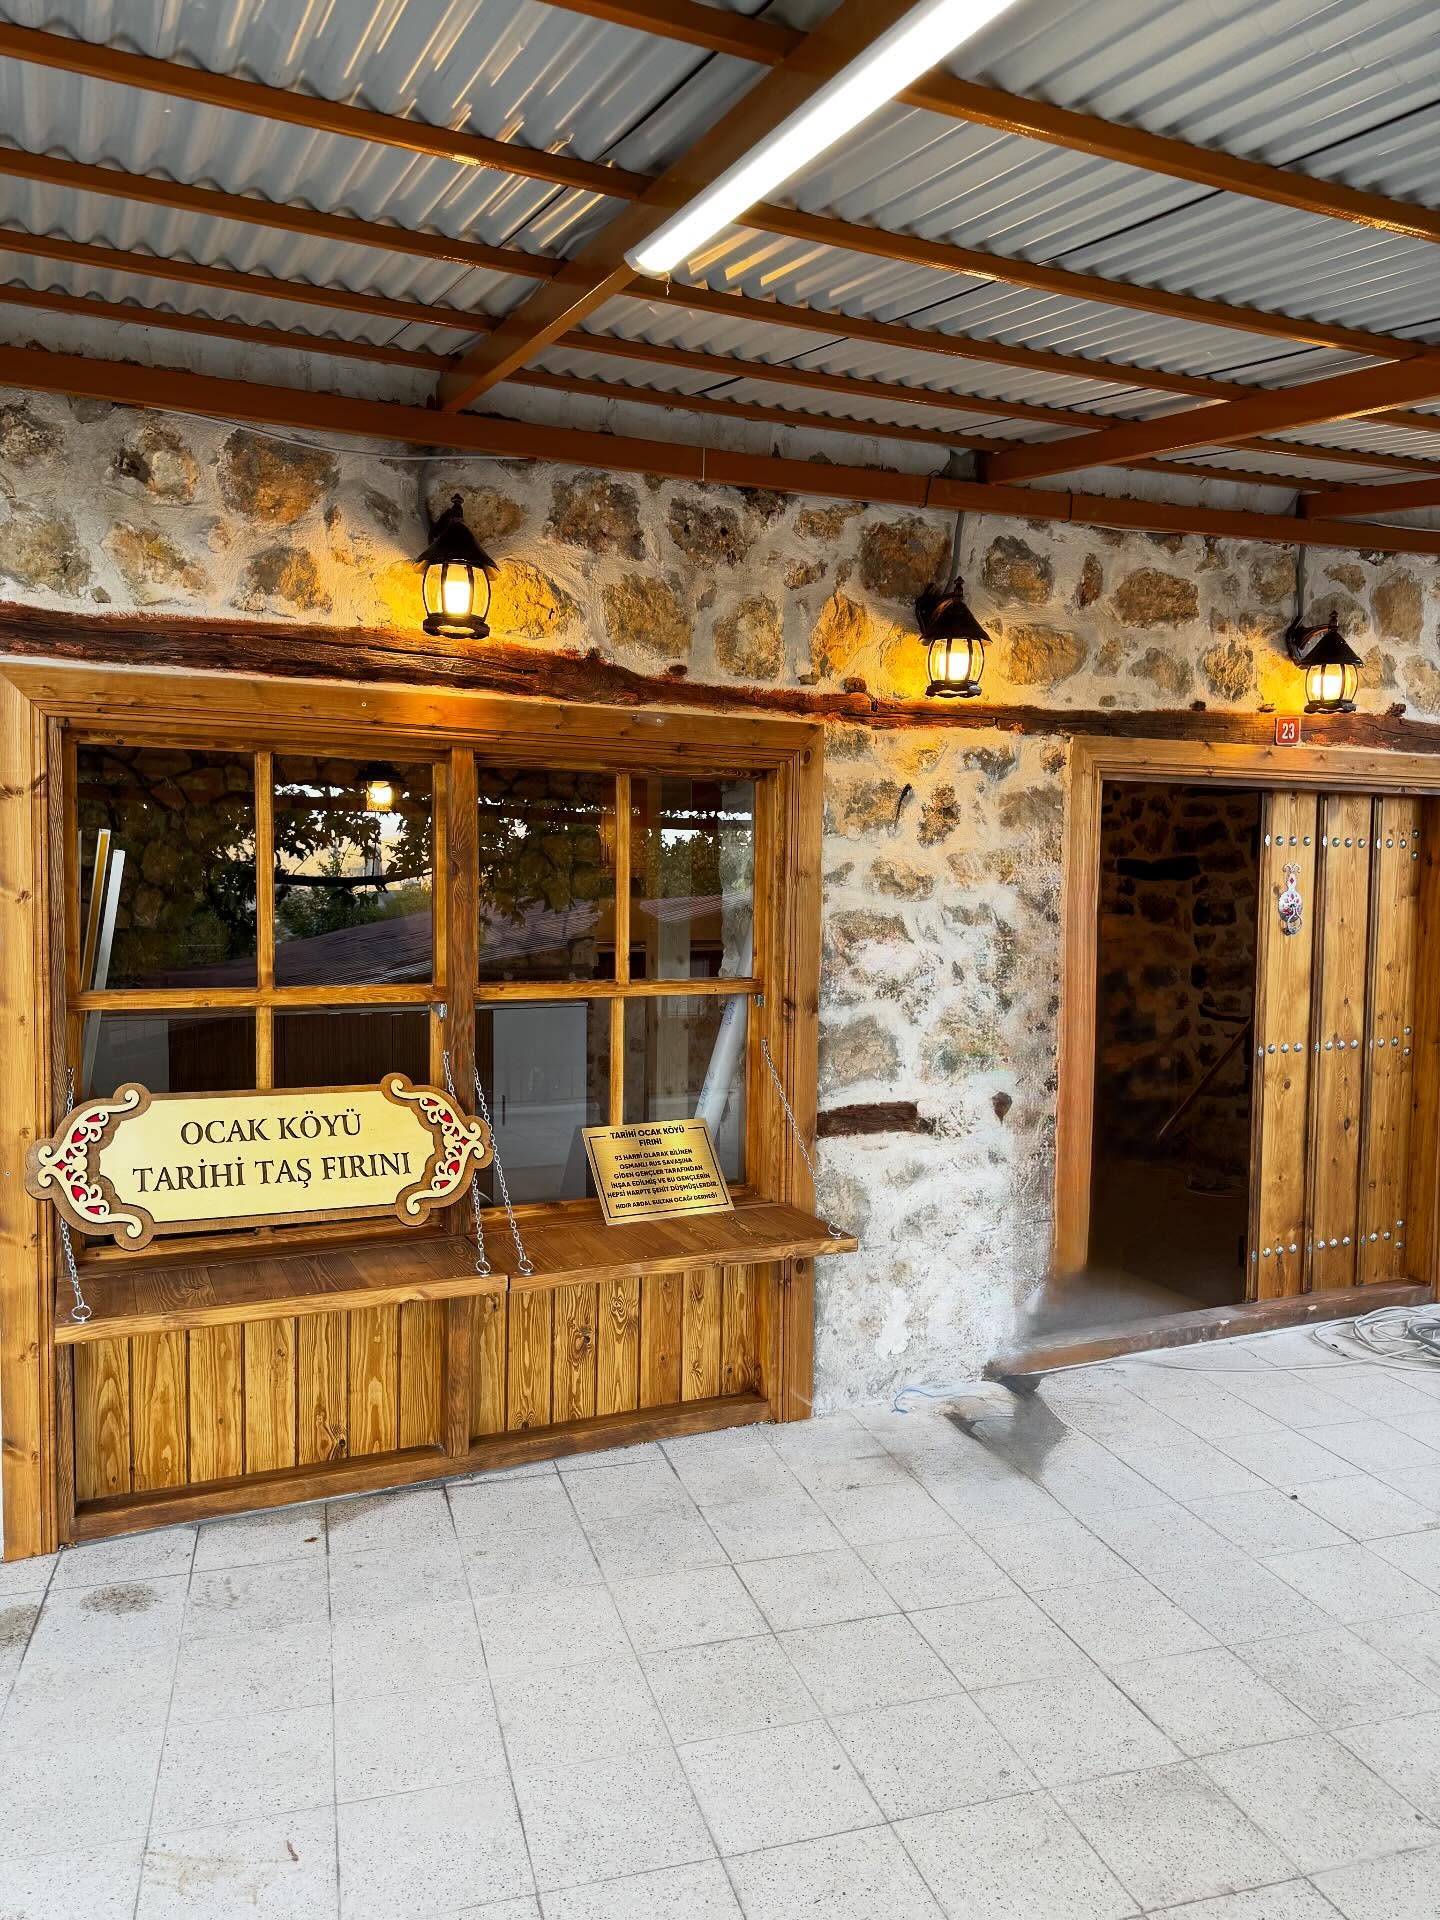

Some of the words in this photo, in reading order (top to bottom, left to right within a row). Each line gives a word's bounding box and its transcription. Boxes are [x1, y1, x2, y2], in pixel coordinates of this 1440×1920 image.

[1282, 723, 1295, 739] 23
[180, 1118, 269, 1146] OCAK
[277, 1108, 362, 1141] KÖYÜ
[610, 1129, 637, 1139] TARİHİ
[638, 1128, 662, 1137] OCAK
[663, 1125, 685, 1134] KÖYÜ
[639, 1138, 662, 1146] FIRINI
[620, 1161, 648, 1170] OSMANLI
[664, 1165, 704, 1174] TARAFINDAN
[132, 1156, 246, 1193] TARİHİ
[254, 1158, 312, 1189] TAŞ
[321, 1152, 412, 1180] FIRINI
[607, 1190, 626, 1198] HEPSİ
